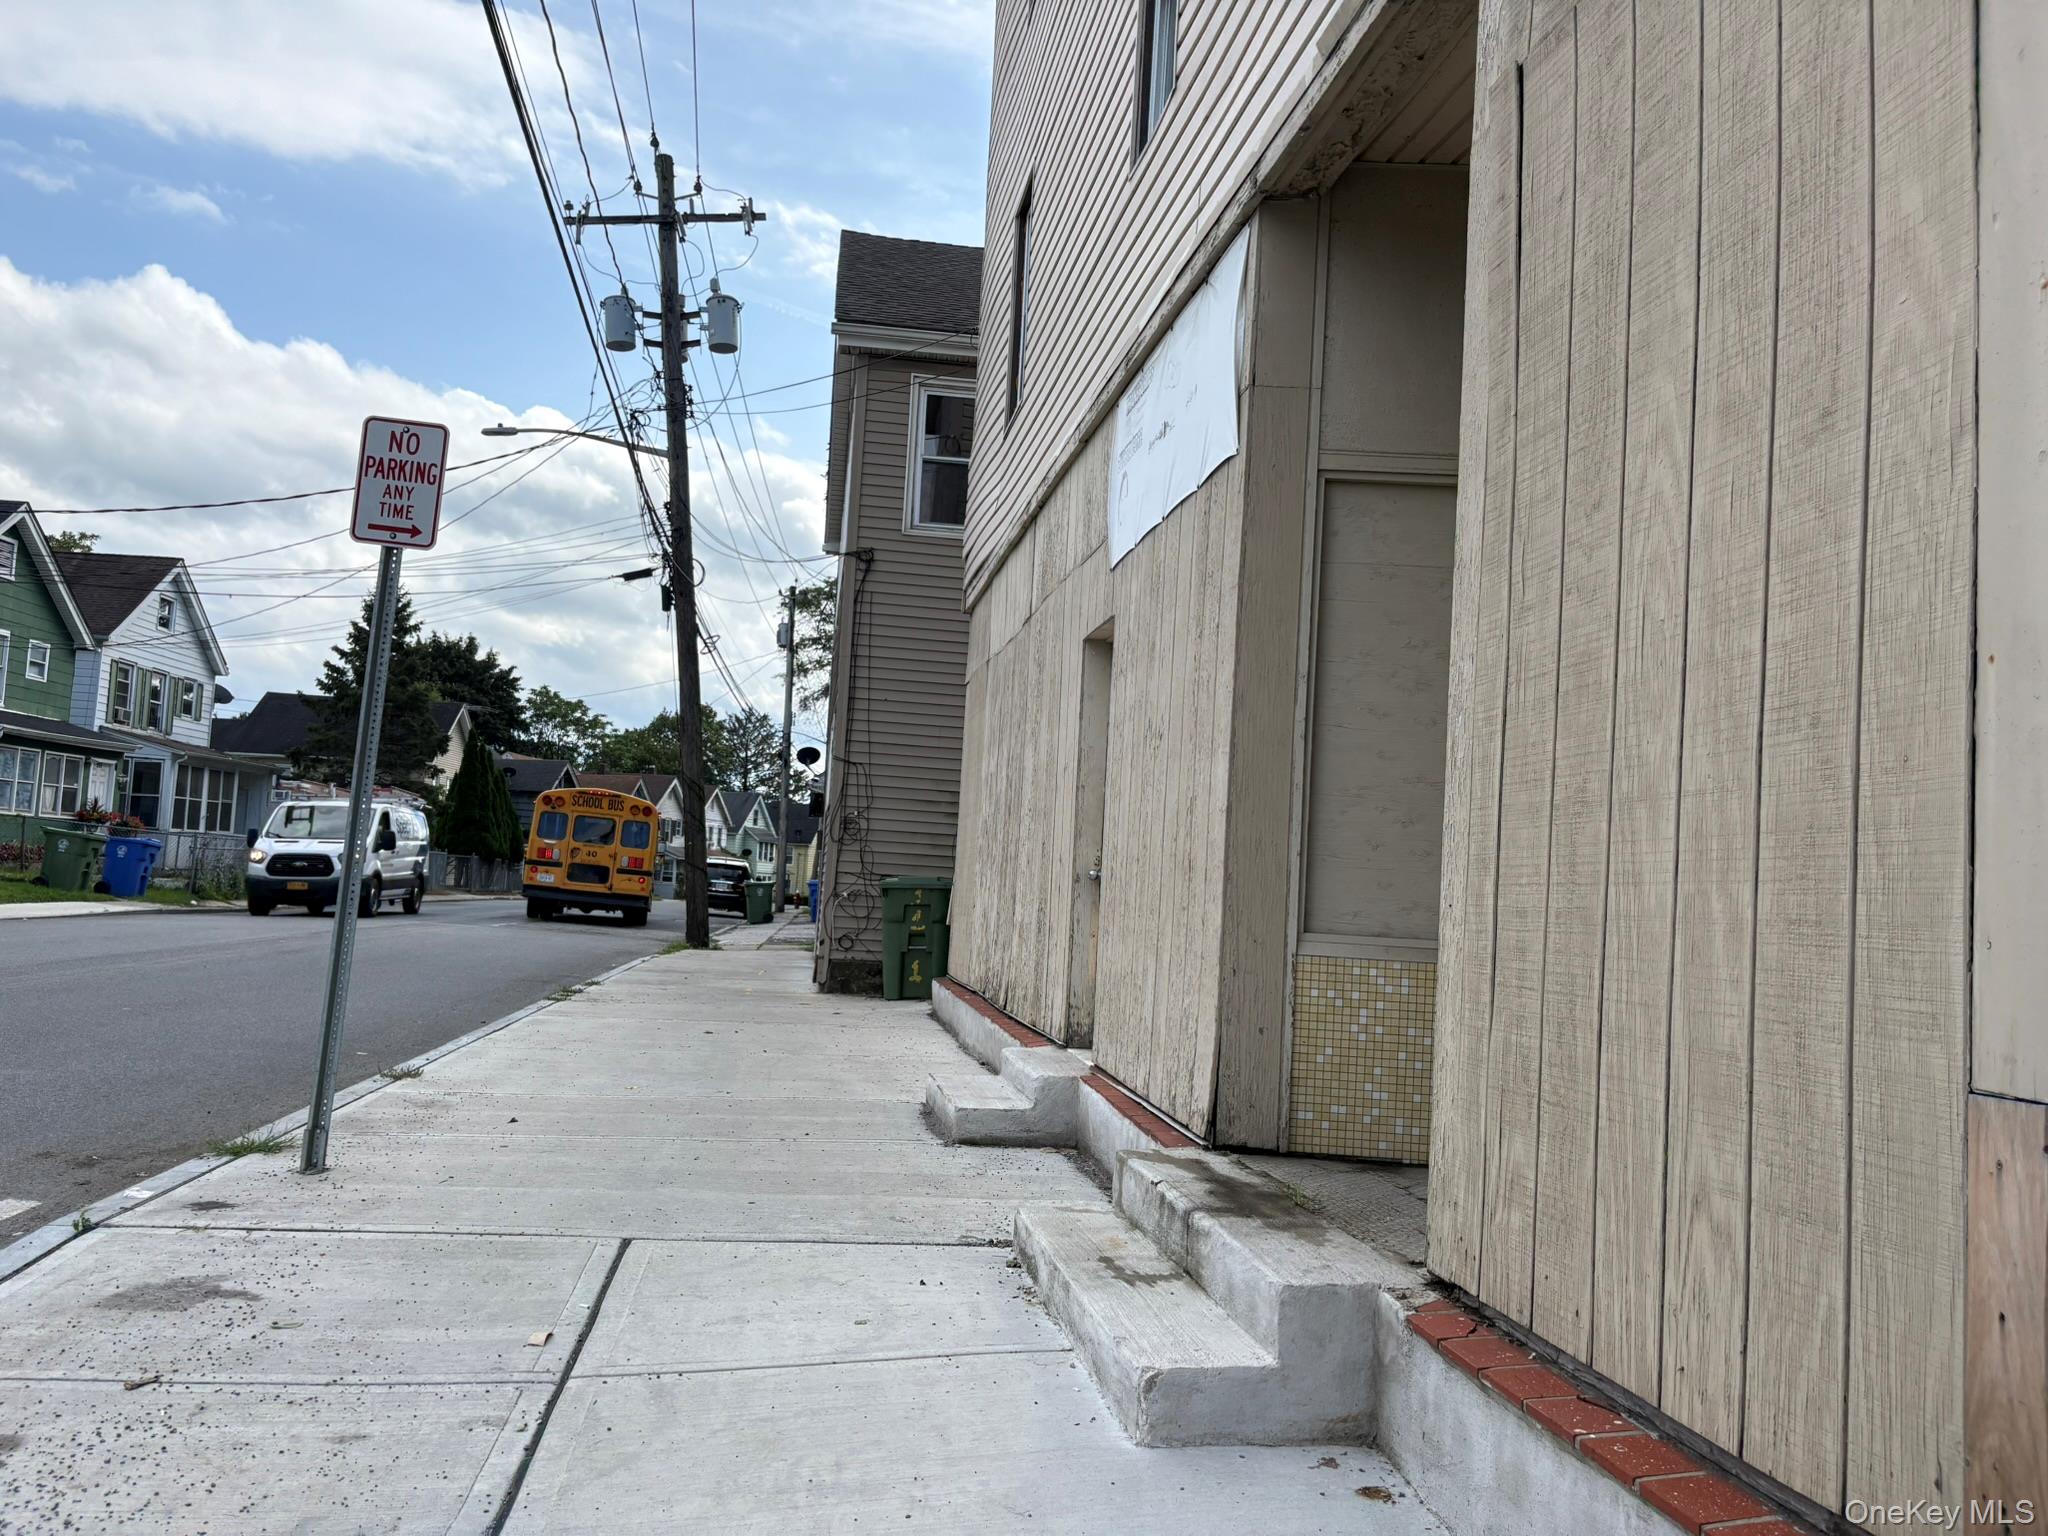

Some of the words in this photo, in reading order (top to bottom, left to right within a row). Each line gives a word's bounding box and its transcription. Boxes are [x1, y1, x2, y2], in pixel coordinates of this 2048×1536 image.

[388, 430, 421, 455] NO
[364, 455, 438, 486] PARKING
[382, 483, 415, 501] ANY
[379, 501, 415, 520] TIME
[571, 794, 605, 810] SCHOOL
[607, 798, 625, 812] BUS
